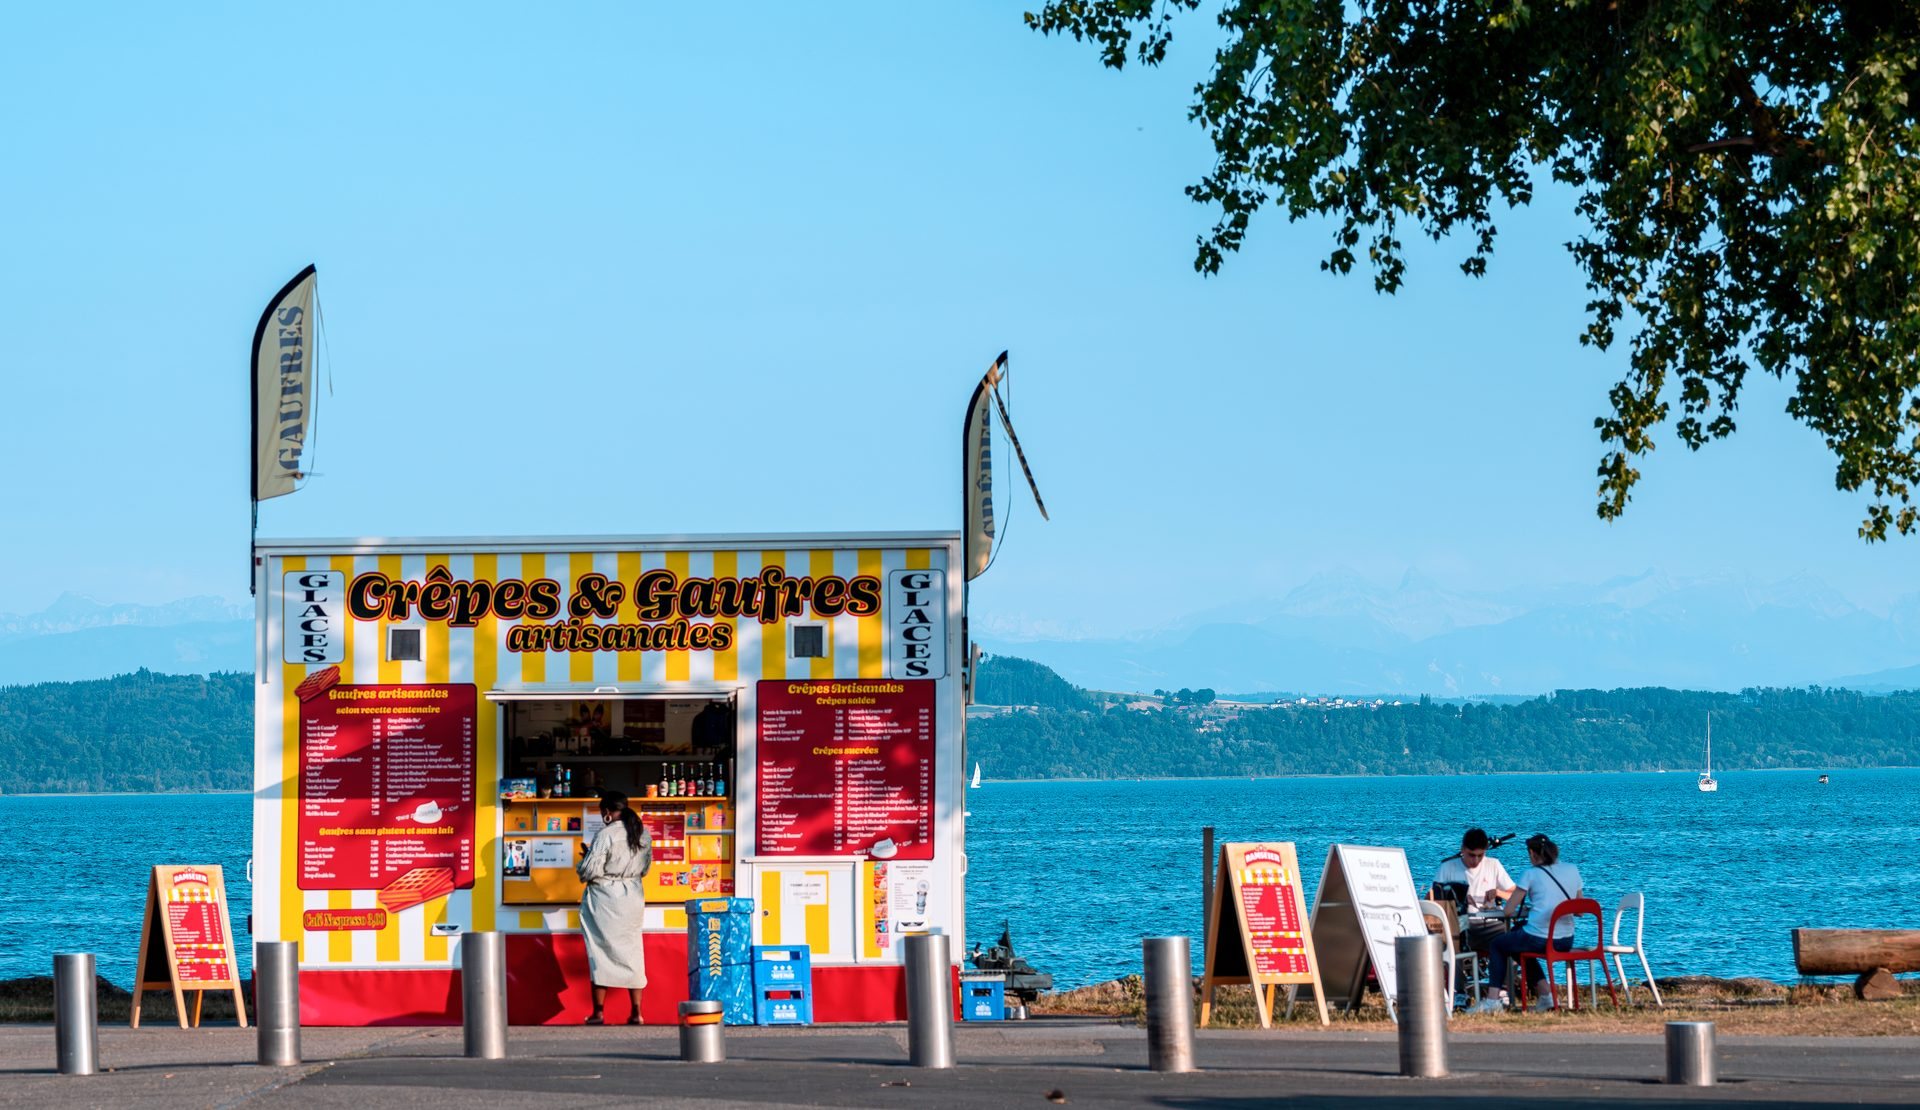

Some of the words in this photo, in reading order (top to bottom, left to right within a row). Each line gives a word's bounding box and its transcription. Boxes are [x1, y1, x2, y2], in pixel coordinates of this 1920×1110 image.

[278, 305, 304, 472] GAUFRES
[347, 565, 562, 627] Crêpes
[568, 572, 626, 621] &
[634, 565, 883, 624] Gaufres
[299, 574, 330, 662] GLACES
[900, 573, 932, 677] GLACES
[507, 617, 733, 653] artisanales
[329, 689, 376, 700] Gaufres
[378, 688, 448, 699] artisanales
[788, 684, 829, 695] Crêpes
[831, 683, 904, 694] Artisanales
[816, 697, 846, 707] Crêpes
[848, 696, 876, 705] salées
[336, 706, 360, 714] selon
[361, 706, 391, 714] recette
[813, 746, 844, 756] Crêpes
[845, 746, 879, 755] sucrées
[319, 827, 354, 837] Gaufres
[355, 828, 376, 836] sans
[377, 827, 405, 837] gluten
[438, 826, 455, 835] lait
[304, 912, 323, 927] Café
[324, 913, 366, 930] Nespresso
